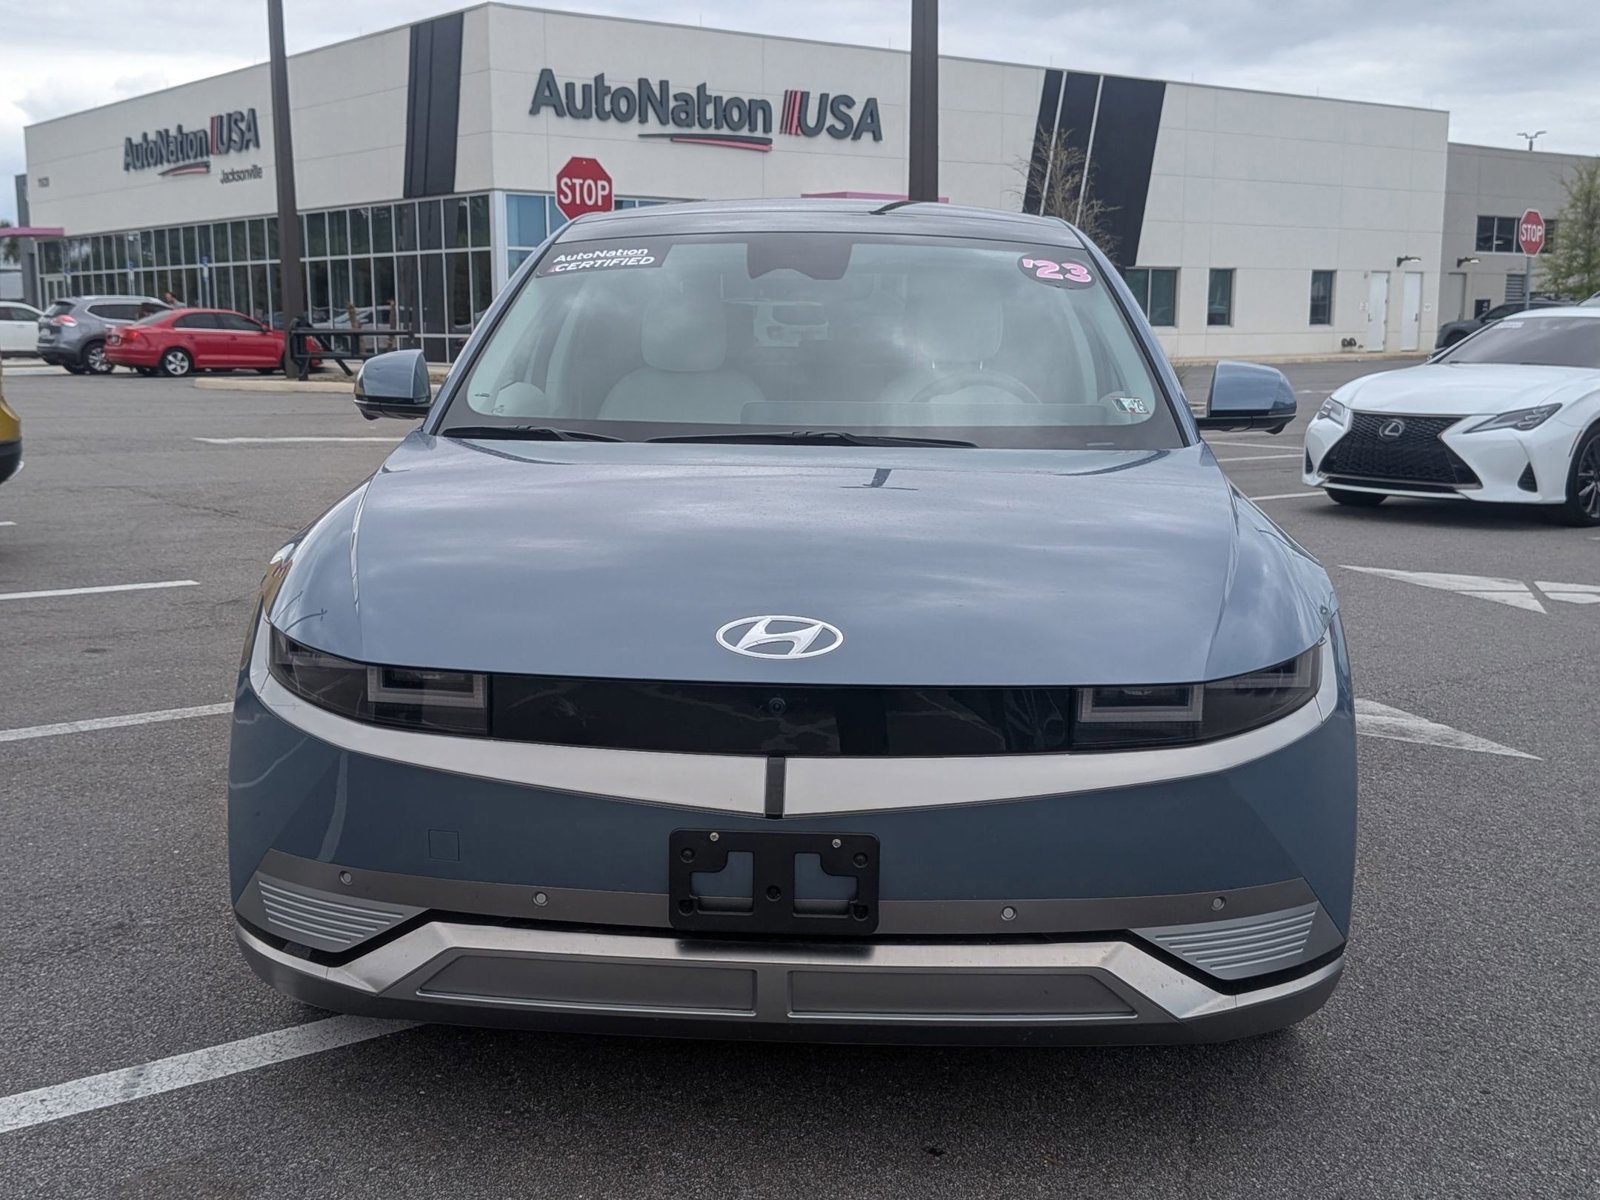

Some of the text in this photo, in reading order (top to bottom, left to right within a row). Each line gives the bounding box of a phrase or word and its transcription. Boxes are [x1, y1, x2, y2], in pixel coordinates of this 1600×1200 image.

[529, 68, 883, 142] AutoNation USA
[123, 107, 261, 172] AutoNation USA
[219, 164, 263, 184] Jacksonville
[559, 177, 610, 206] STOP
[1520, 223, 1544, 242] STOP
[553, 248, 649, 263] AutoNation
[554, 256, 656, 272] CERTIFIED
[1022, 258, 1092, 283] '23
